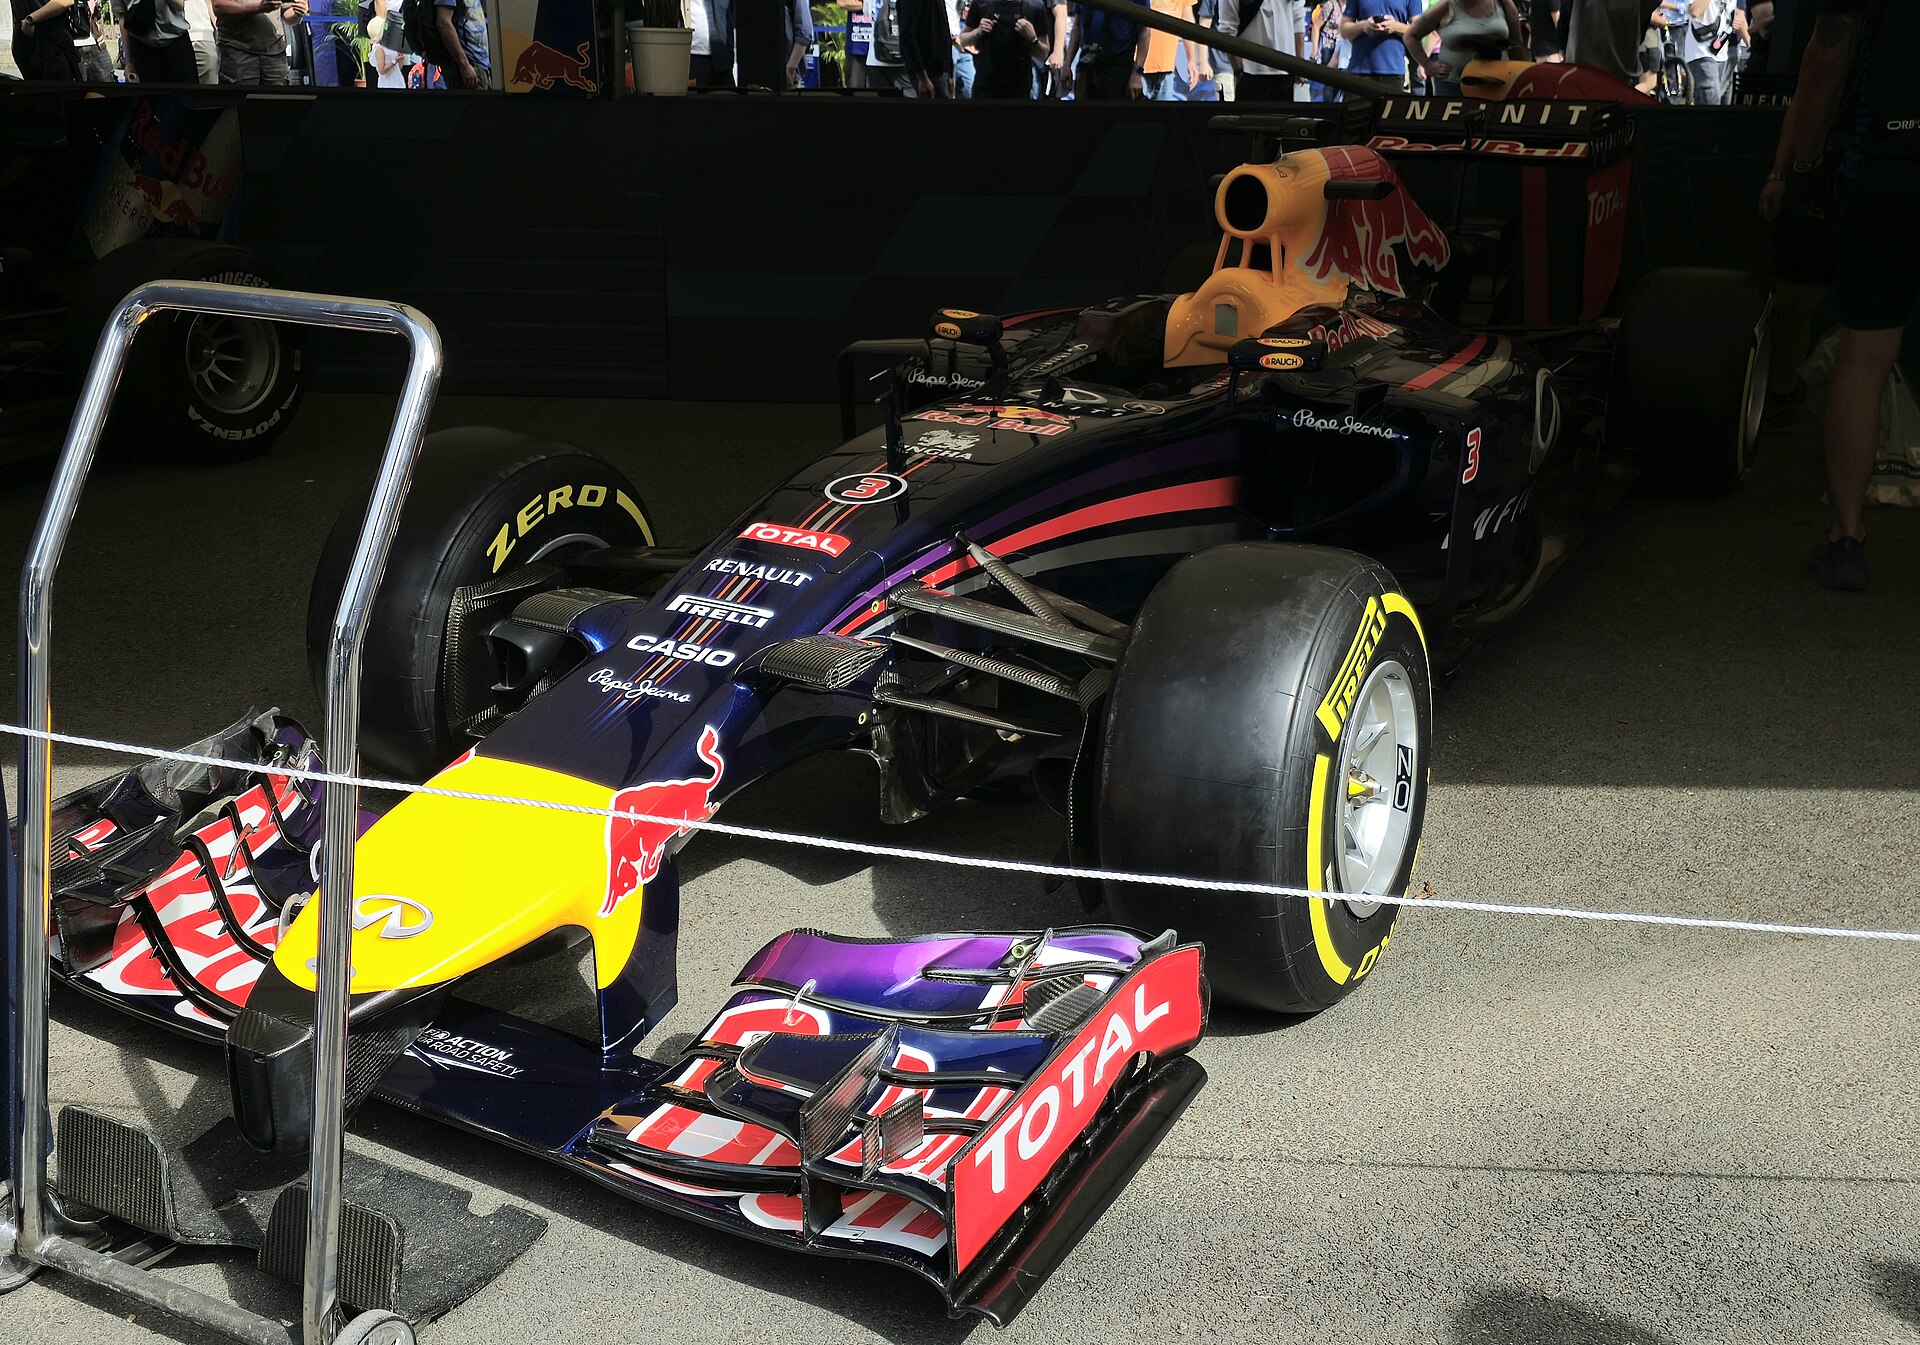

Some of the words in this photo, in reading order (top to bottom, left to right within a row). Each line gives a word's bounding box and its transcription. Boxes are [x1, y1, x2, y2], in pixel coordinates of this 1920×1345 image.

[941, 326, 958, 336] RAUCH
[1270, 357, 1298, 366] RAUCH
[908, 367, 948, 388] Pepe
[948, 373, 986, 390] Jean
[187, 404, 281, 441] POTENZA
[911, 409, 990, 427] Red
[986, 417, 1072, 436] Bull
[1293, 408, 1340, 432] Pepe
[1339, 415, 1394, 440] Jeans
[1462, 426, 1482, 485] 3
[841, 477, 891, 499] 3
[486, 484, 607, 574] ZERO
[743, 522, 838, 554] TOTAL
[702, 558, 813, 587] RENAULT
[664, 594, 775, 629] PIRELLI
[626, 634, 736, 667] CASIO
[588, 668, 632, 692] Pepe
[625, 679, 691, 703] Jeans
[1314, 596, 1388, 743] PIRELLI
[429, 1041, 471, 1059] ROAD
[466, 1054, 524, 1076] SAFETY
[443, 1036, 513, 1062] ACTION
[974, 984, 1170, 1194] TOTAL
